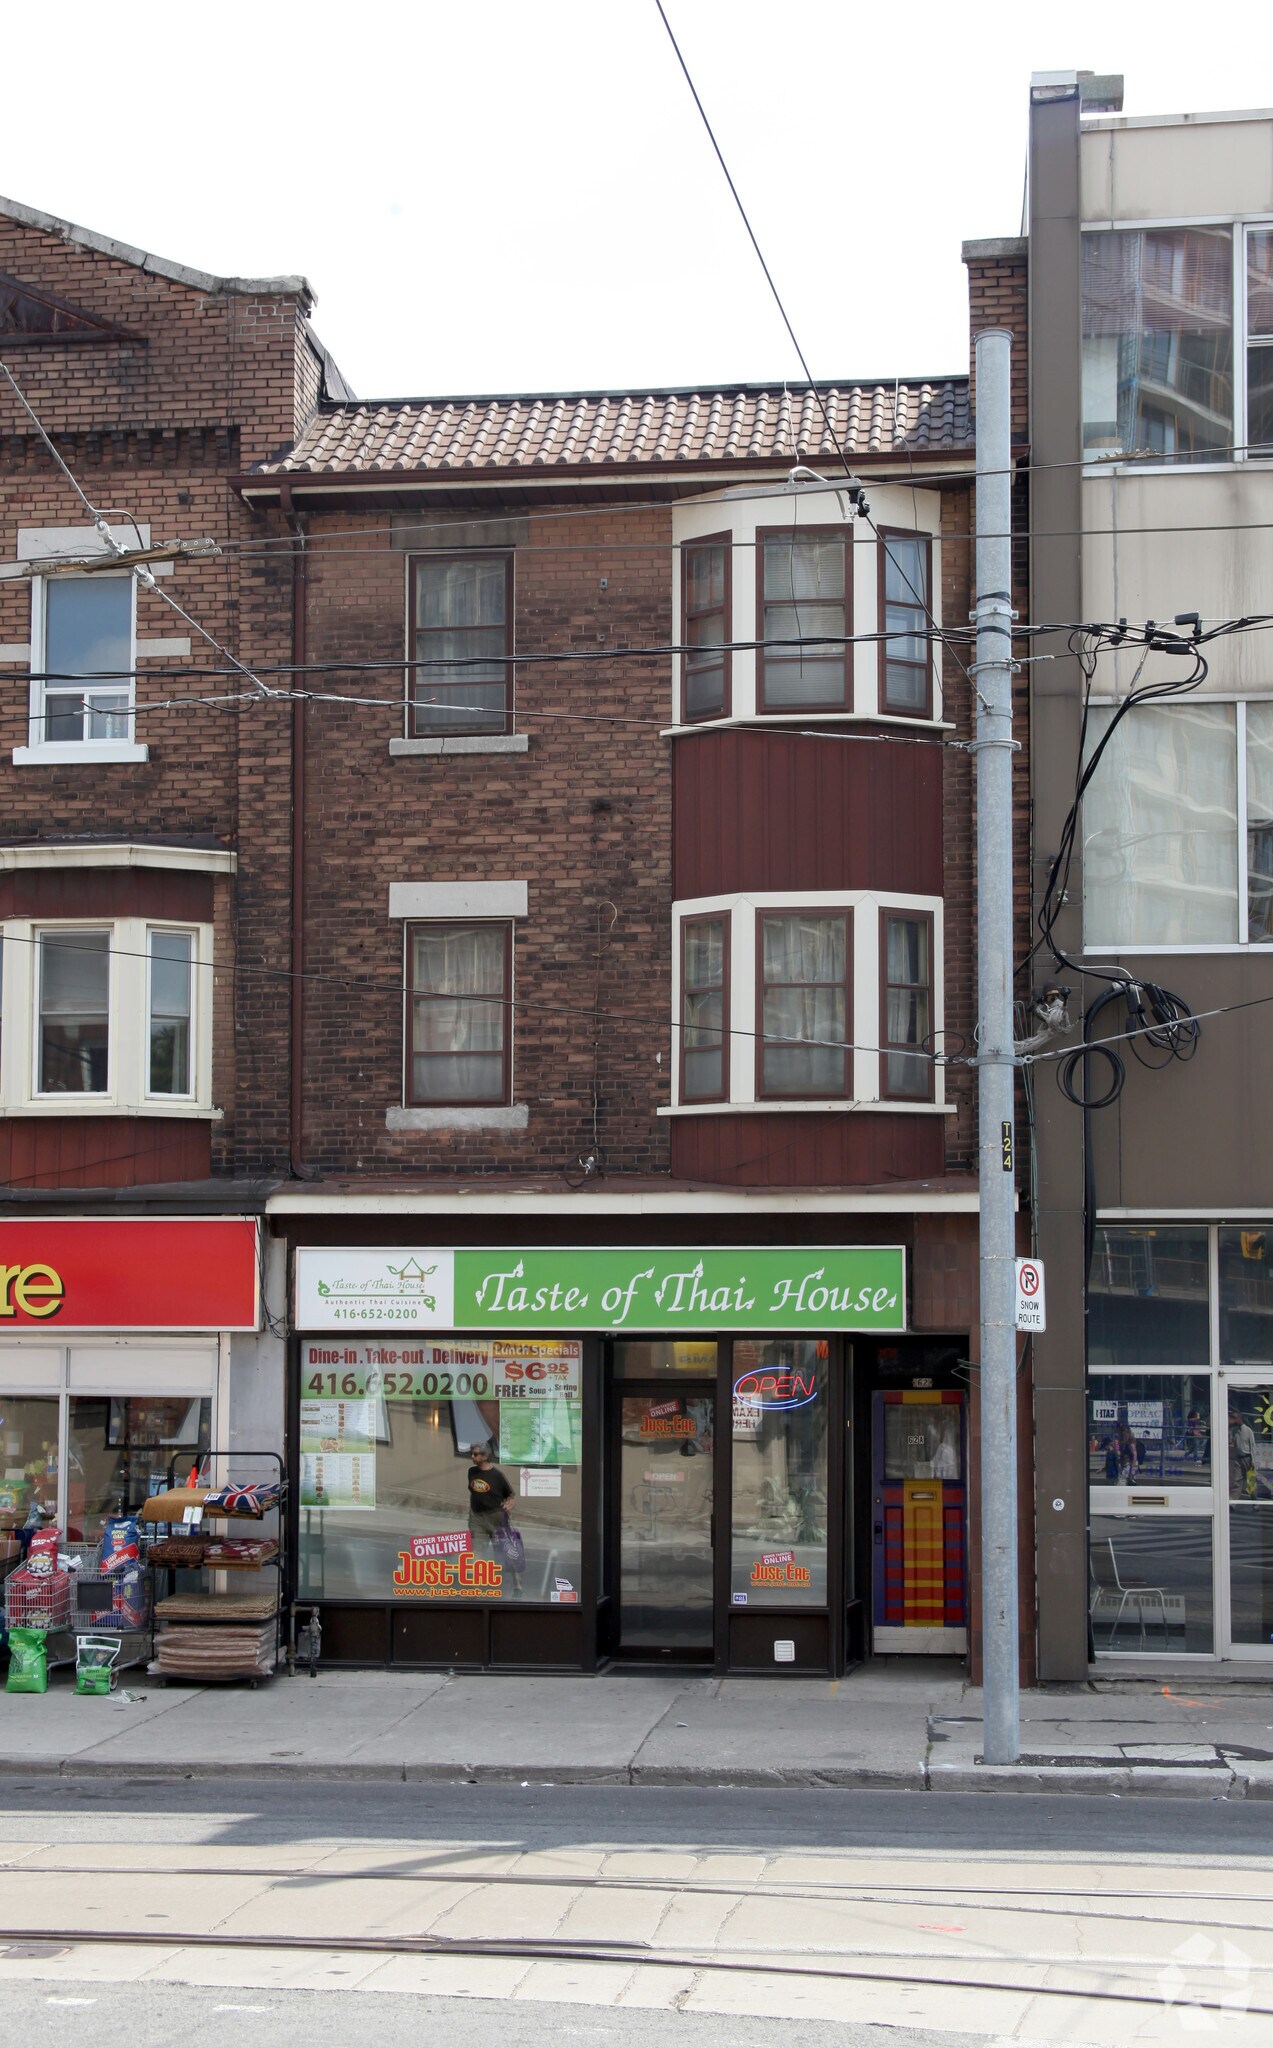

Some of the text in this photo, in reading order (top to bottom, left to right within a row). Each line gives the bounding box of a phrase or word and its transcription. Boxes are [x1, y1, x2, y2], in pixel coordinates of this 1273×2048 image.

[332, 1278, 425, 1291] Taste of Thai House
[475, 1258, 898, 1325] Taste of Thai House
[1020, 1300, 1040, 1311] SNOW
[1018, 1313, 1041, 1324] ROUTE
[432, 1347, 488, 1366] Delivery
[495, 1343, 529, 1355] Lunch
[531, 1343, 579, 1358] Specials
[308, 1372, 488, 1396] 416.652.0200
[738, 1375, 816, 1398] OPEN
[495, 1384, 526, 1398] FREE
[529, 1387, 547, 1395] Soup
[650, 1405, 677, 1417] ONLINE
[652, 1472, 677, 1480] OPEN
[413, 1533, 467, 1546] ORDER TAKEOUT
[414, 1540, 468, 1557] ONLINE
[763, 1555, 793, 1565] ONLINE
[393, 1587, 502, 1598] www.just-eat.ca
